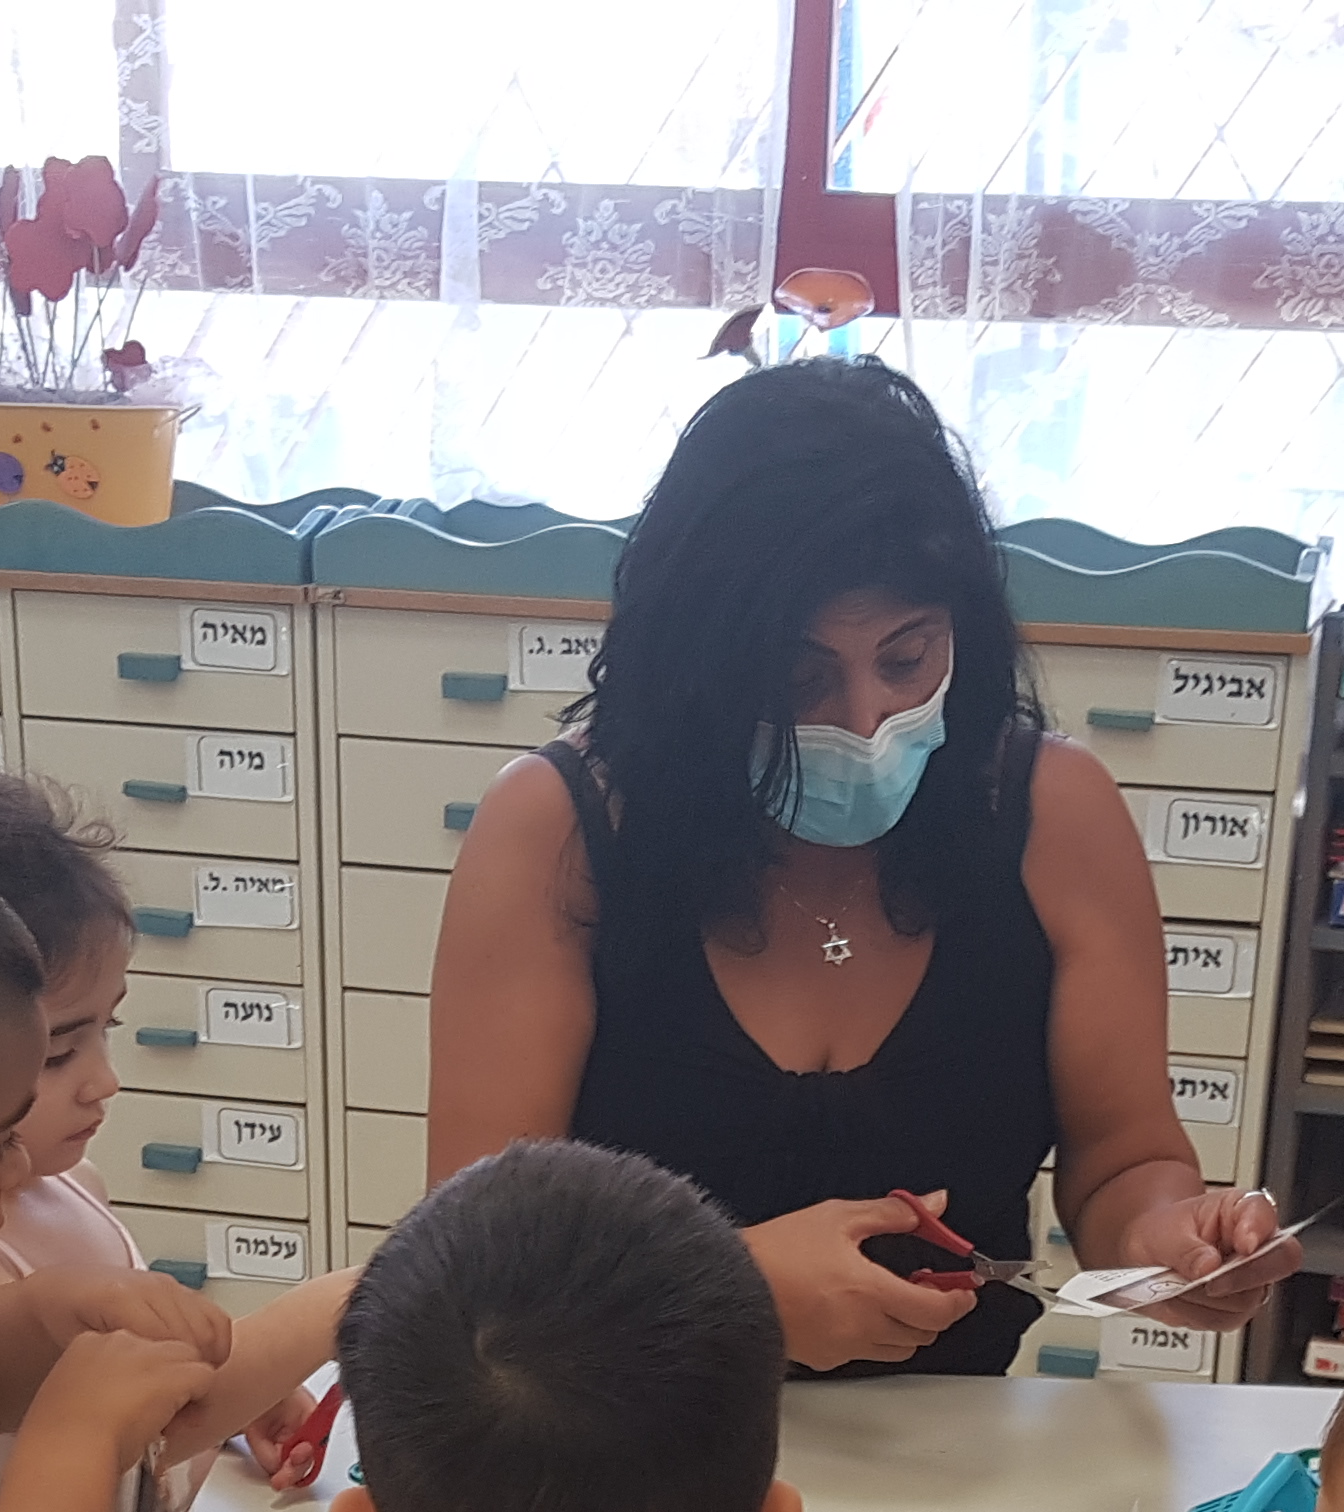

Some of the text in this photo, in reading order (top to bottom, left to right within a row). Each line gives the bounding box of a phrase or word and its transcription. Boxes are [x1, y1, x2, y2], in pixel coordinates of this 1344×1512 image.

[200, 620, 267, 646] מאיה
[1173, 667, 1266, 700] אביגיל
[217, 746, 265, 770] מיה
[1180, 811, 1249, 839] אורון
[1167, 946, 1223, 968] אית
[223, 1001, 275, 1023] נועה
[234, 1119, 283, 1144] עידן
[235, 1235, 298, 1260] עלמה
[1131, 1326, 1189, 1350] אמה
